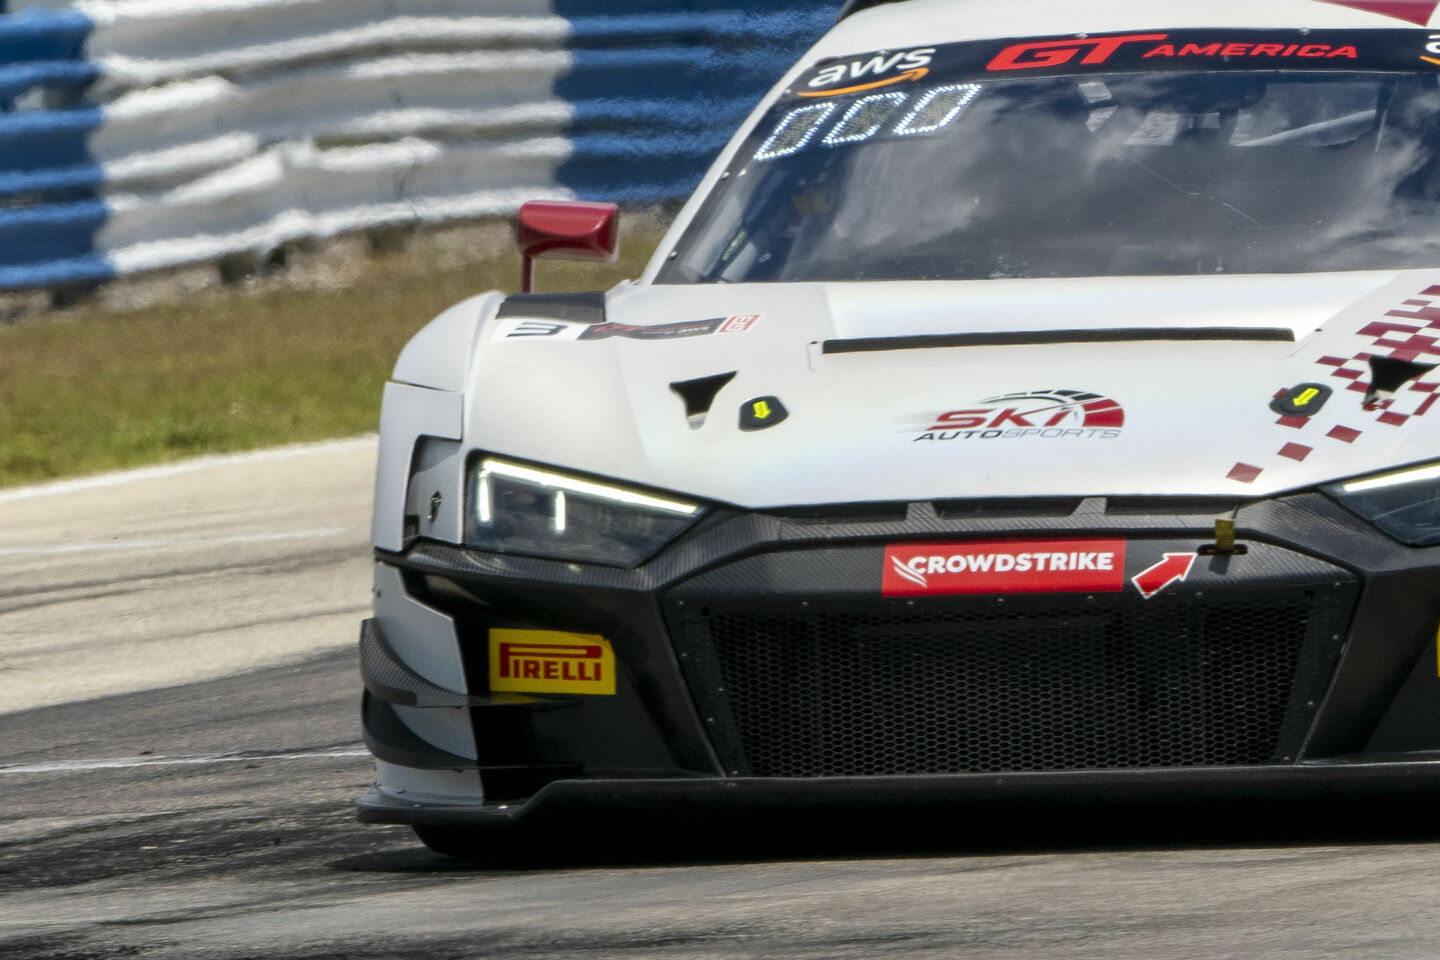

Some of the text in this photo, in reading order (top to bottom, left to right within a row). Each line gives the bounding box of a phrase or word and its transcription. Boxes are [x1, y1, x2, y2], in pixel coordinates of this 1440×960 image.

[808, 48, 936, 87] aws
[985, 34, 1359, 71] GT AMERICA
[912, 428, 1122, 442] AUTOSPORTS
[907, 551, 1114, 575] CROWDSTRIKE
[499, 642, 603, 682] PIRELLI
